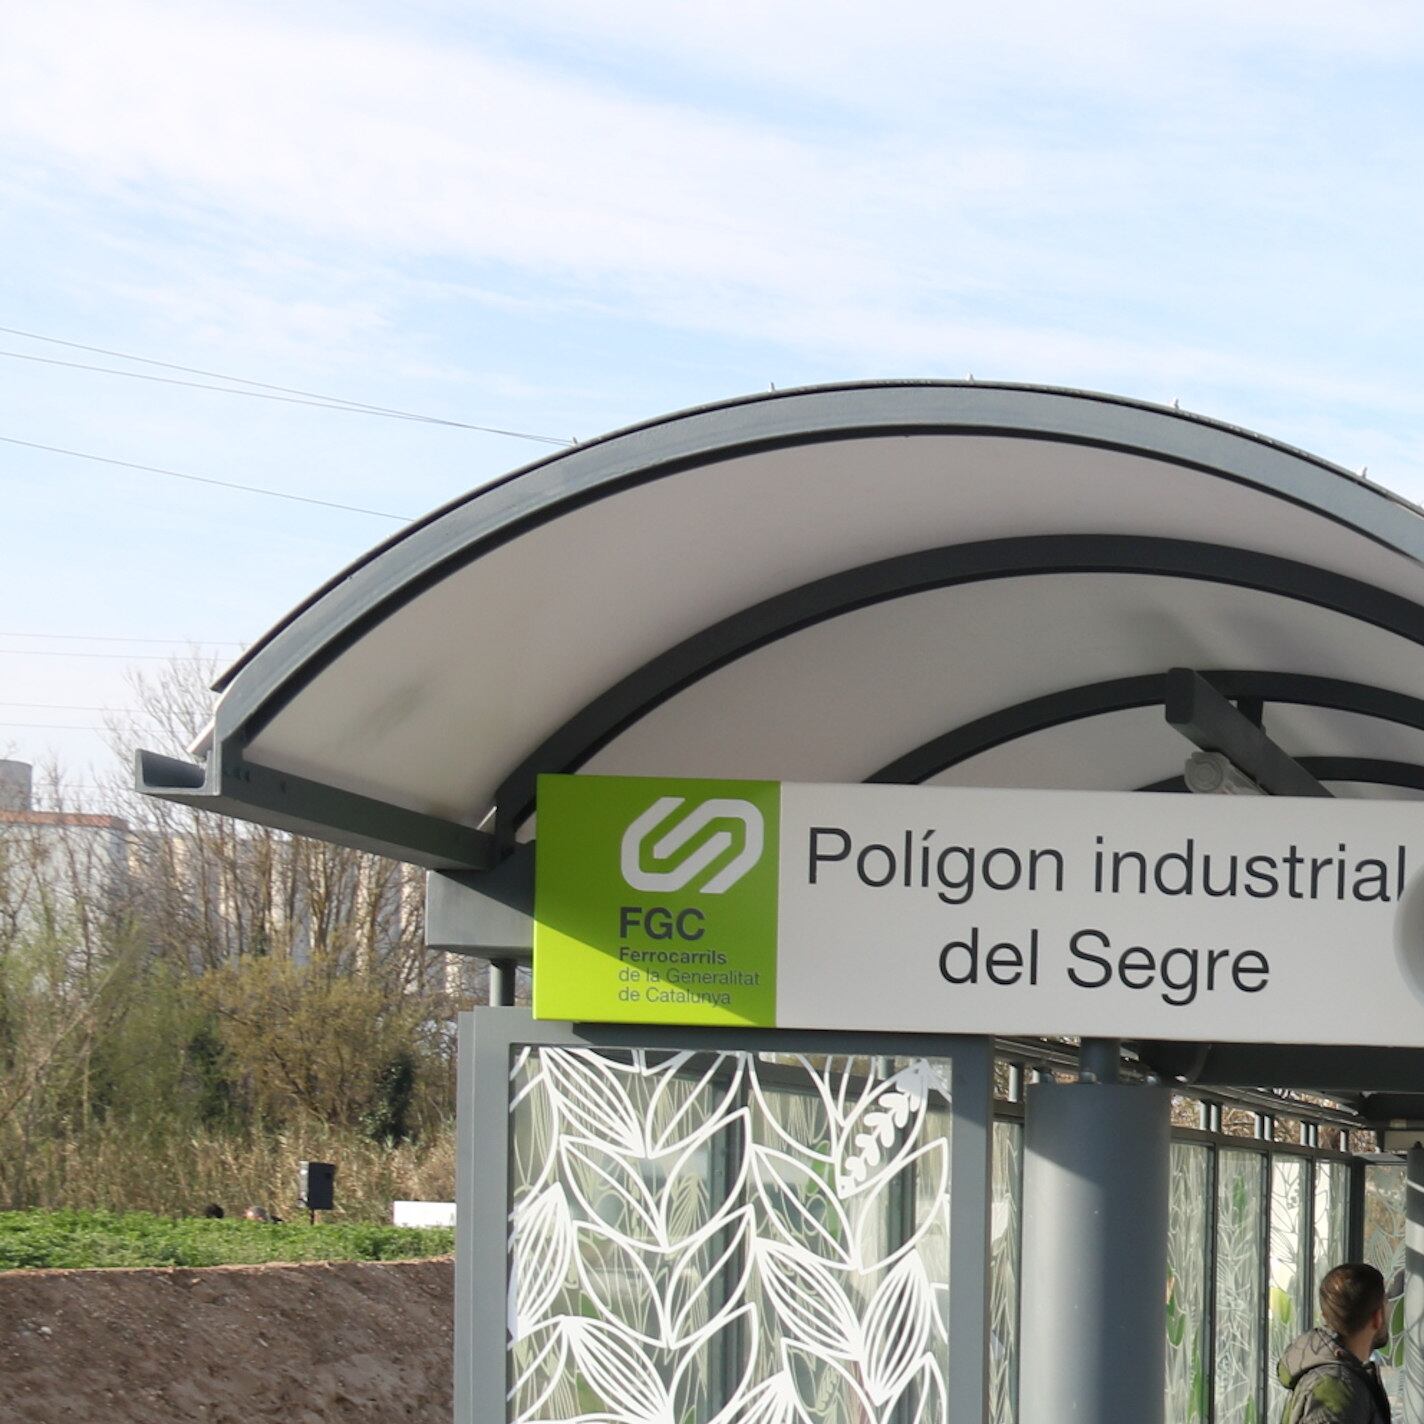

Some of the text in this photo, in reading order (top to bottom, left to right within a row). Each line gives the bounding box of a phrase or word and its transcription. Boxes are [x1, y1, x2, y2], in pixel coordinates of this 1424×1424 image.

[808, 826, 1406, 905] Polígon industrial
[619, 906, 705, 941] FGC
[619, 947, 728, 965] Ferrocarrils
[939, 927, 1270, 1007] del Segre
[618, 968, 760, 986] de la Generalitat
[618, 986, 731, 1007] de Catalunya
